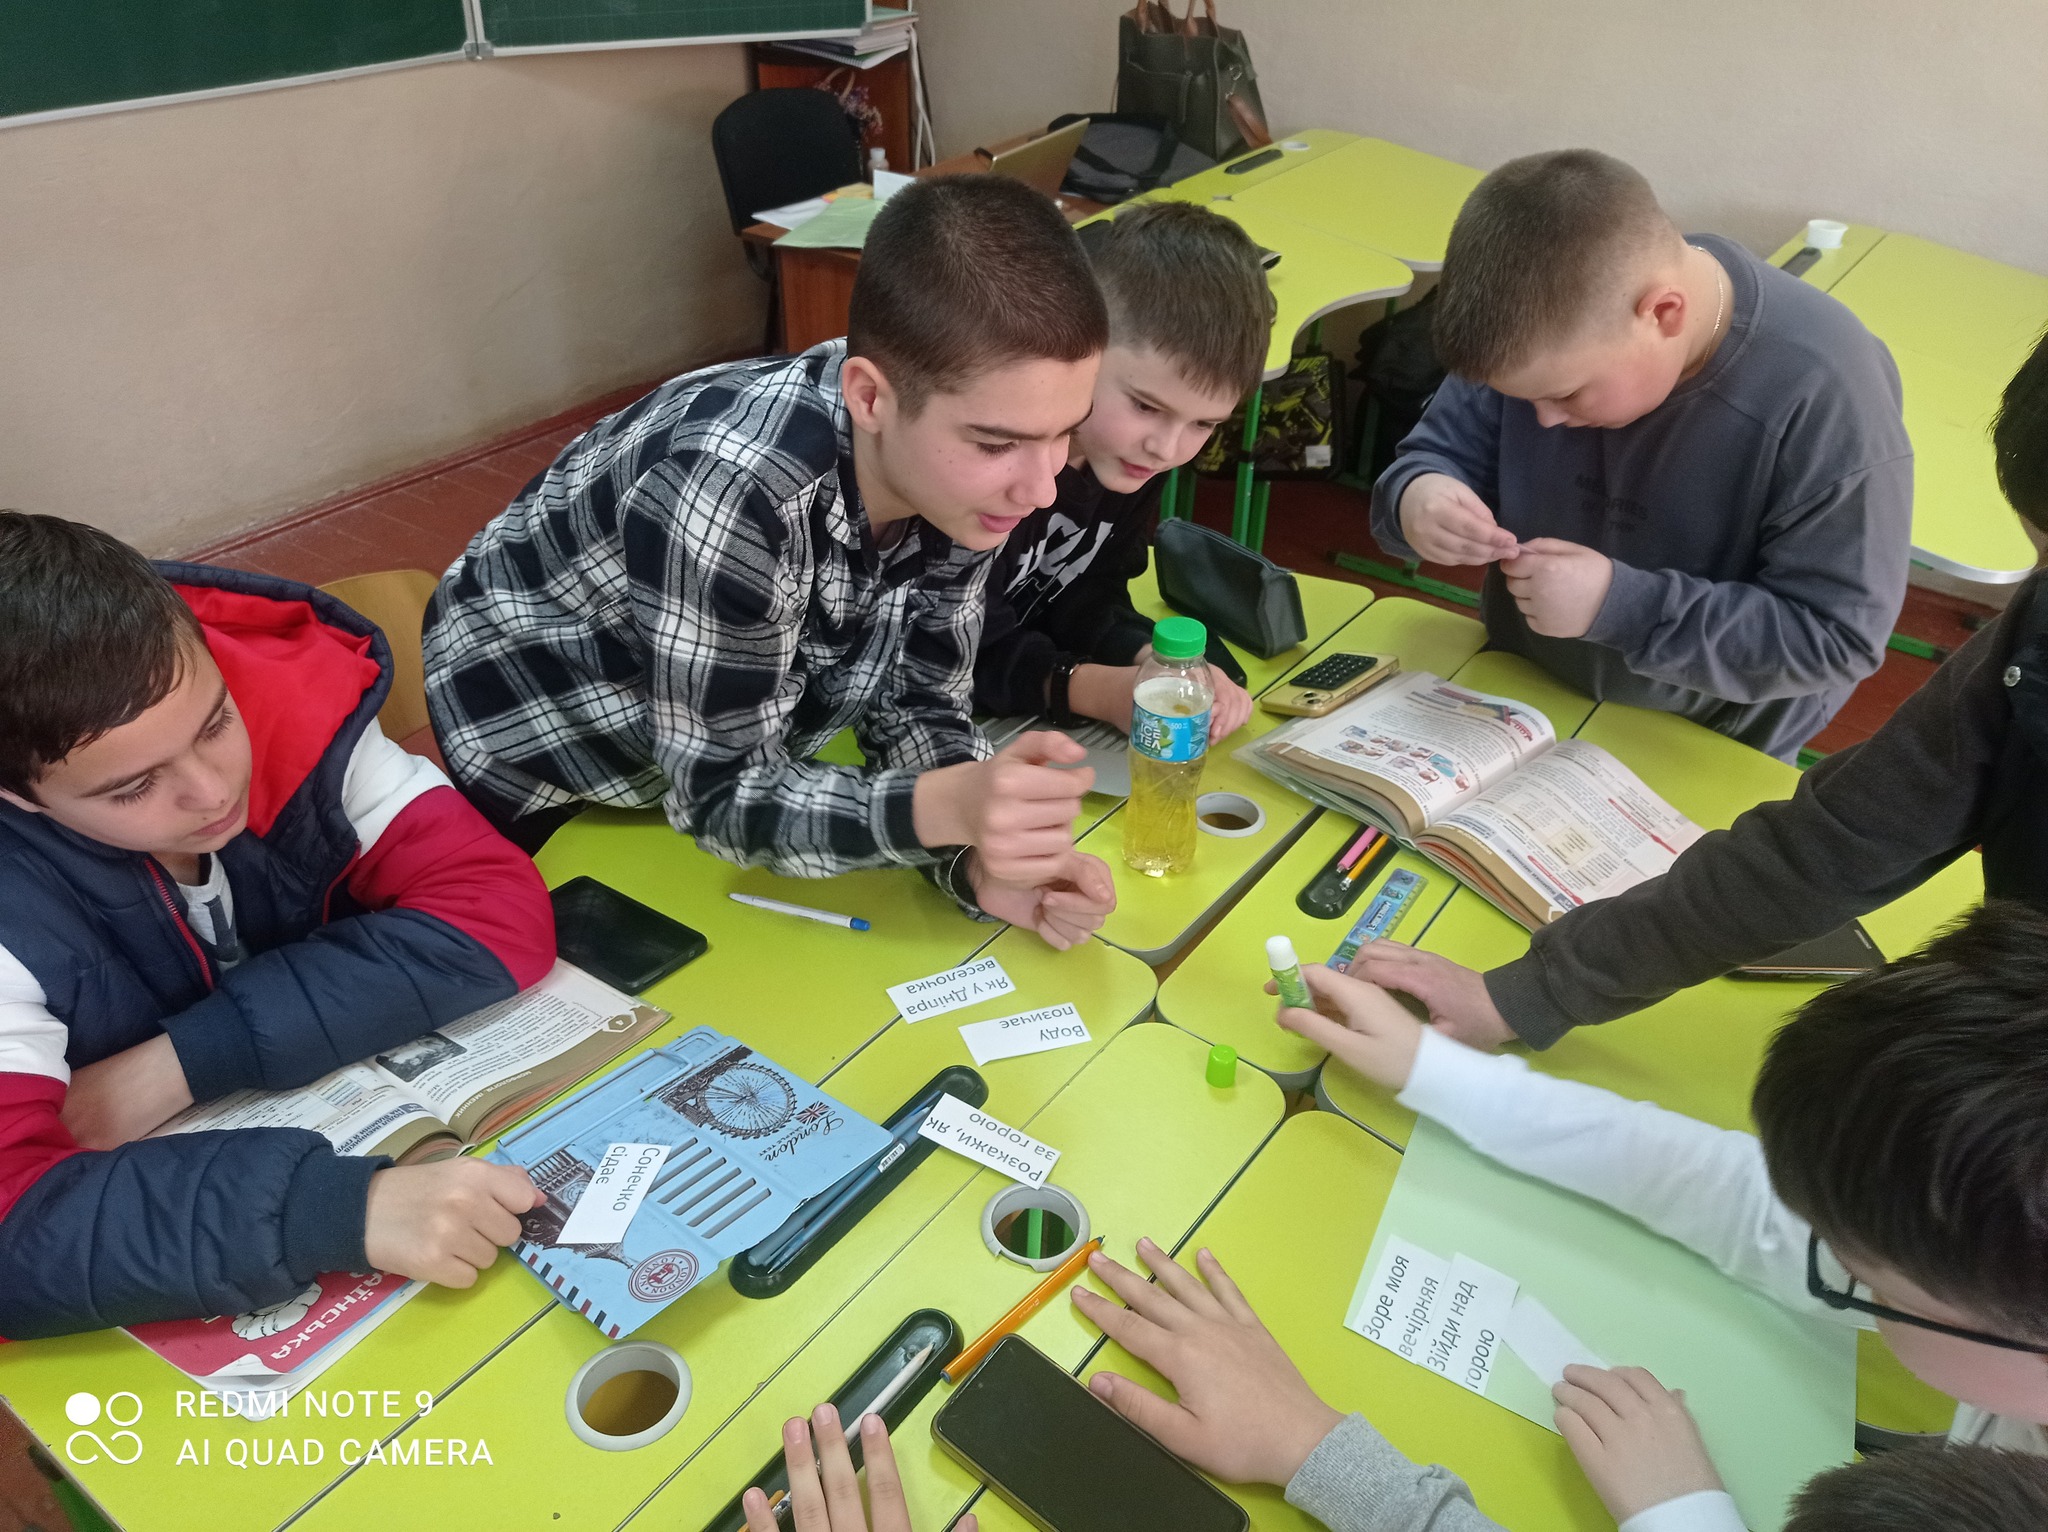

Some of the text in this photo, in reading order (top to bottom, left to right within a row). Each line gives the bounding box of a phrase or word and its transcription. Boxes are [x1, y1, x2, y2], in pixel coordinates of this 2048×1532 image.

[1139, 733, 1161, 750] TEA
[1140, 723, 1161, 739] ICE
[906, 959, 996, 995] веселочка
[906, 976, 1009, 1015] Як у Дніпра
[998, 1006, 1074, 1029] позичає
[1039, 1025, 1085, 1042] Воду
[343, 1123, 381, 1153] ІМЕННИКІВ
[764, 1110, 844, 1161] London
[926, 1117, 1043, 1181] Розкажи, як
[969, 1113, 1056, 1161] за горою
[595, 1146, 628, 1184] сідає
[612, 1147, 661, 1212] Сонечко
[271, 1271, 392, 1360] АЇНСЬКА
[1362, 1255, 1410, 1340] Зоре моя
[1398, 1276, 1439, 1357] вечірняя
[1427, 1280, 1479, 1372] Зійди над
[1464, 1329, 1496, 1389] горою
